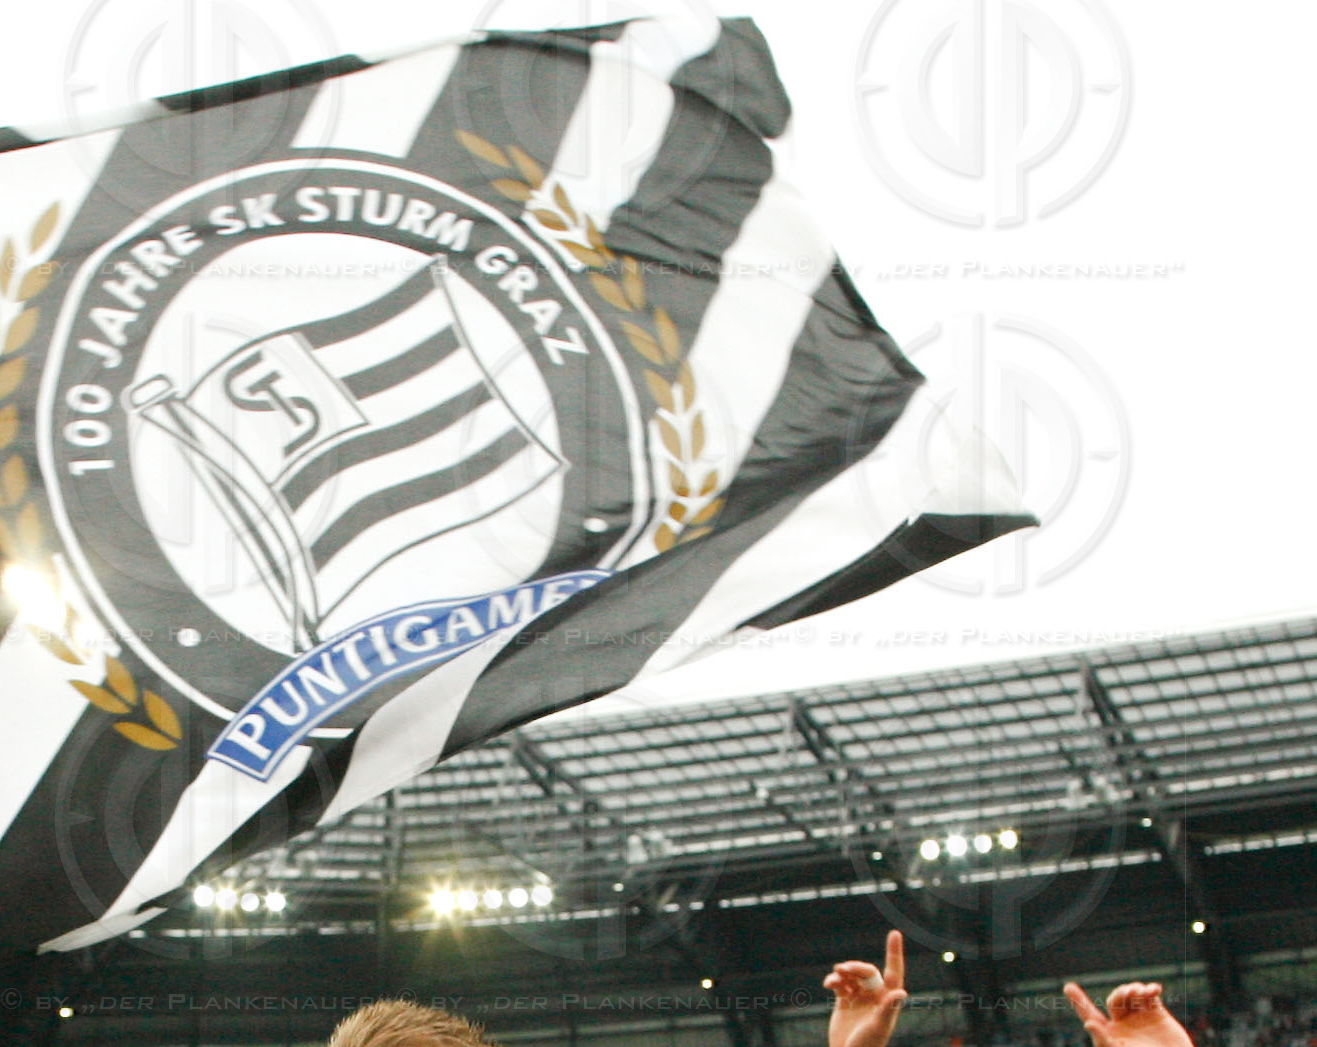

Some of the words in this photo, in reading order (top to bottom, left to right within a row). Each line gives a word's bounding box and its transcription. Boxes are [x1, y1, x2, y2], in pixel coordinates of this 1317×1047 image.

[209, 194, 285, 236] SK
[295, 186, 476, 252] STURM
[79, 225, 203, 368] JAHRE
[475, 245, 590, 366] GRAZ
[64, 383, 115, 475] 100
[226, 578, 598, 761] PUNTIGAME
